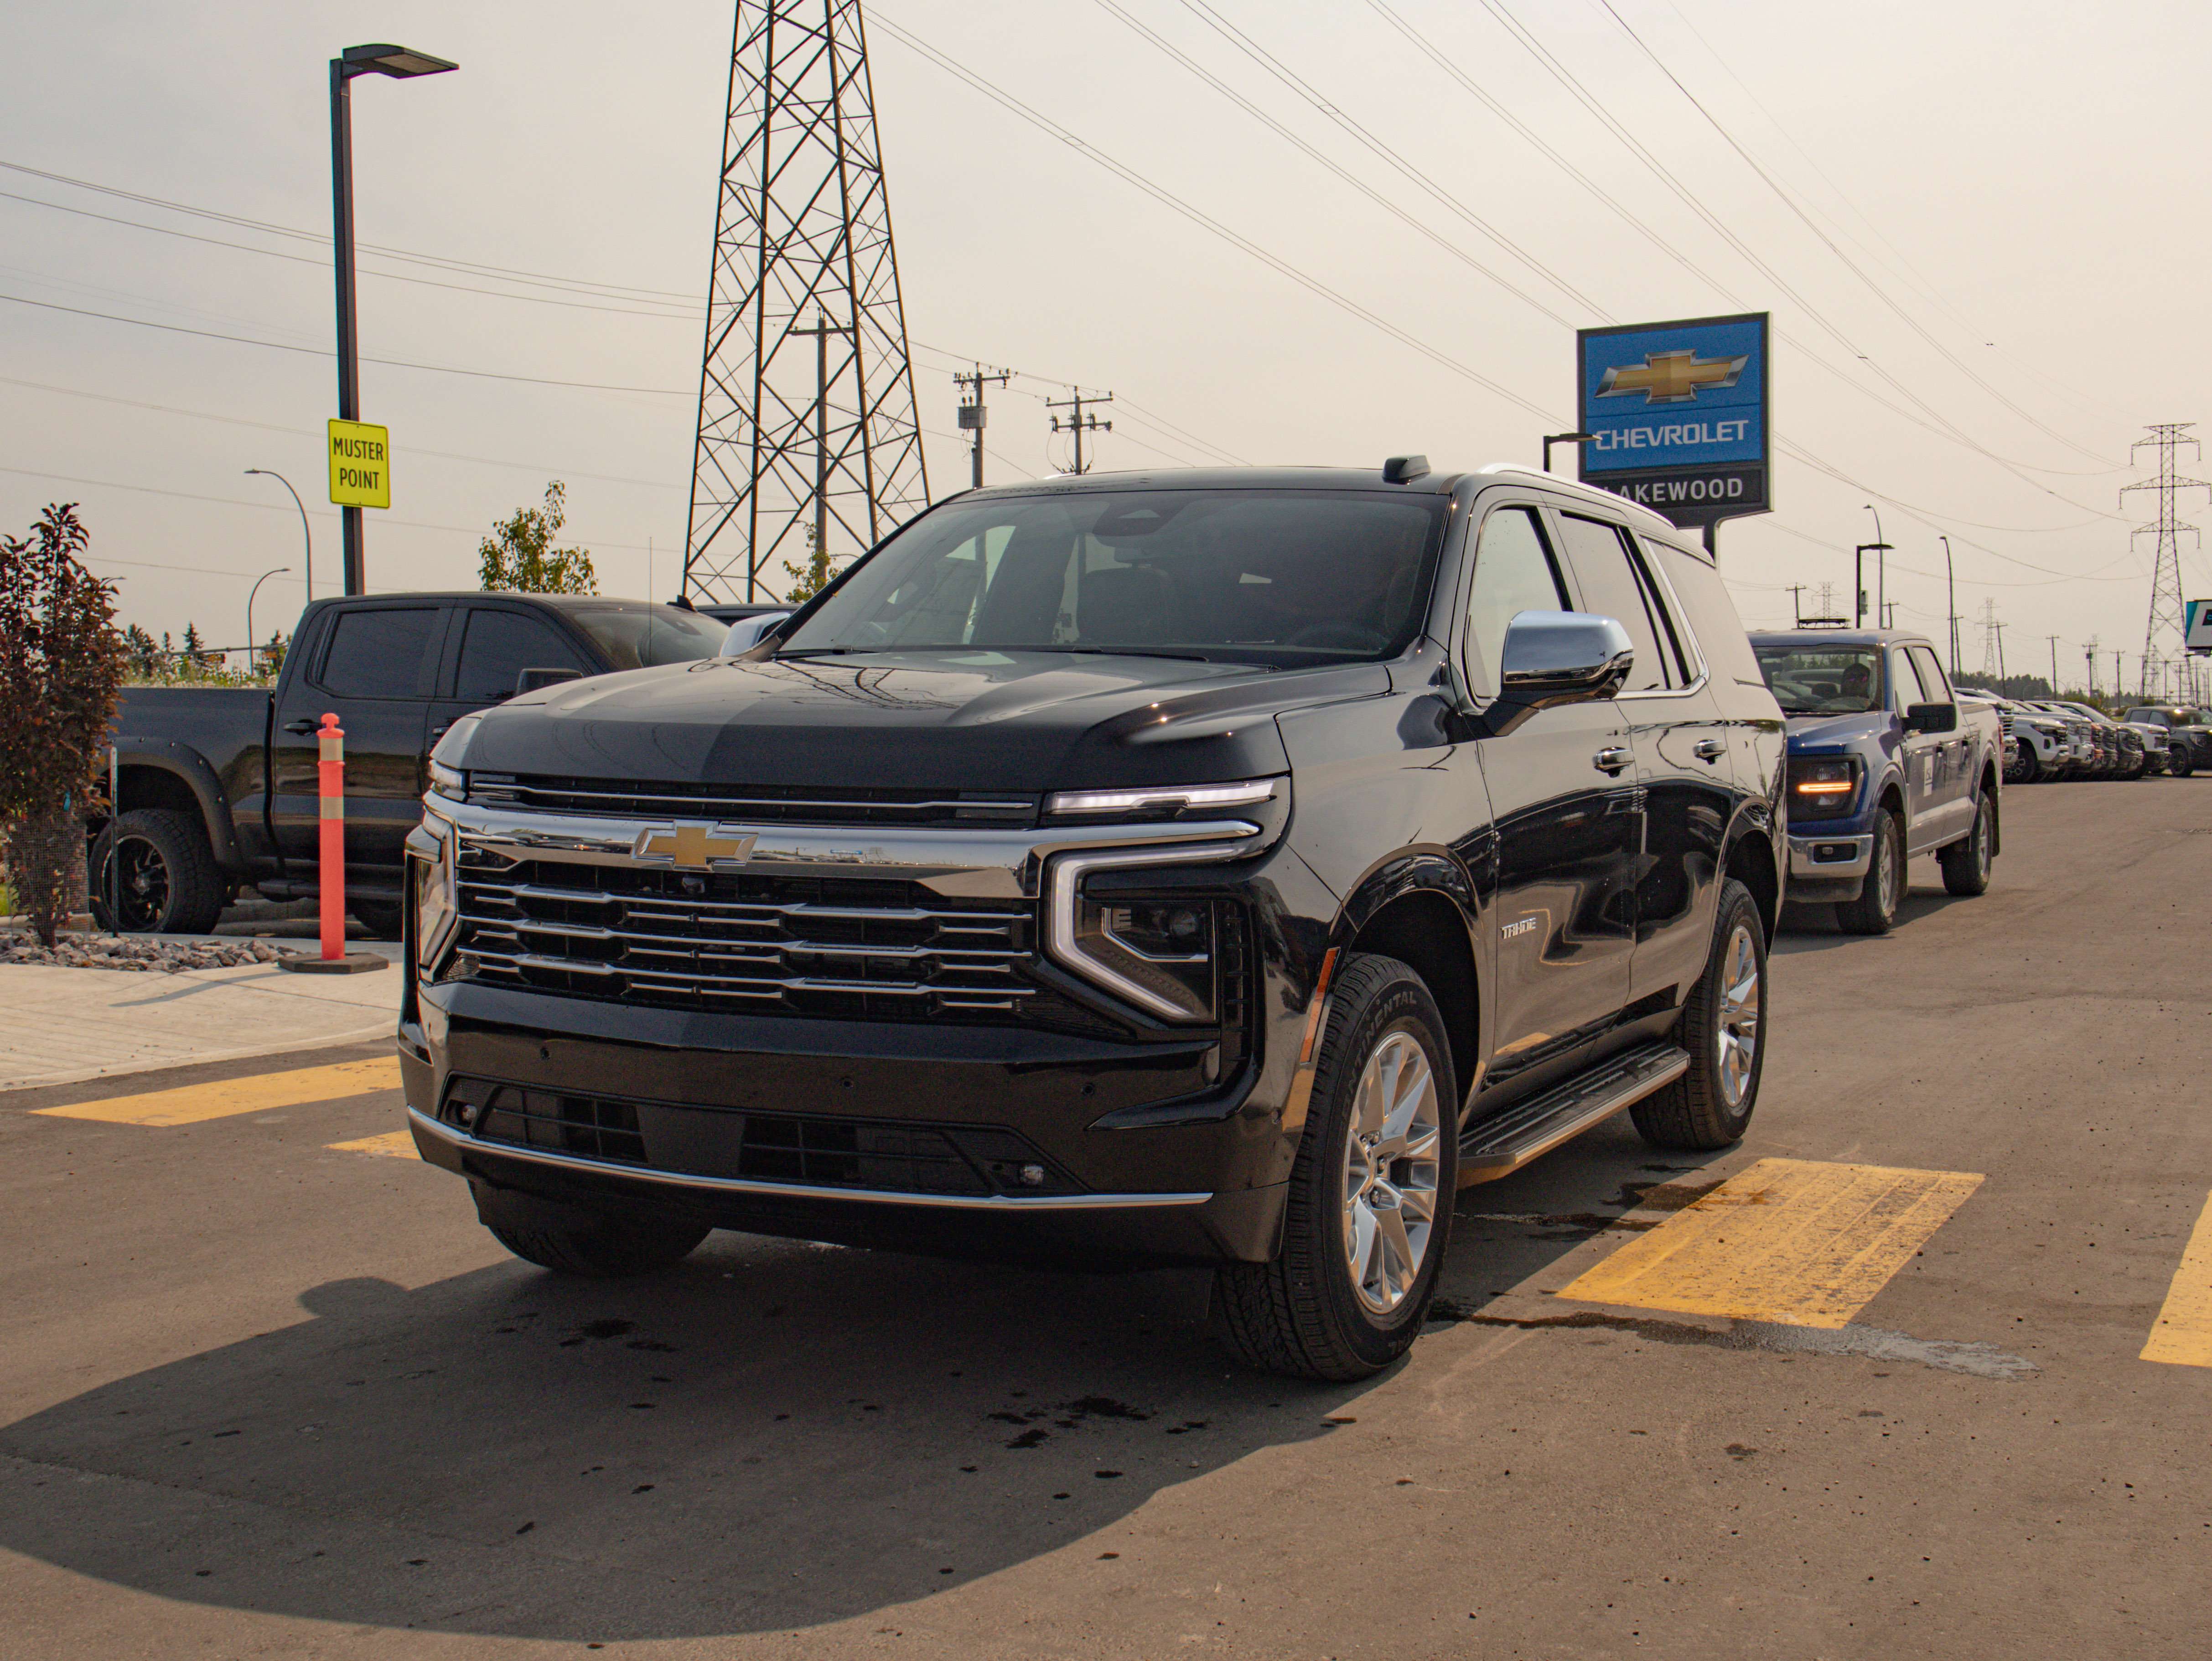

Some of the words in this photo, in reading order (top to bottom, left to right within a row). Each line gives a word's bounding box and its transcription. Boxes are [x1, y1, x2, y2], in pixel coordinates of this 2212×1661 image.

[1596, 420, 1749, 450] CHEVROLET
[333, 436, 384, 461] MUSTER
[339, 467, 379, 490] POINT
[1501, 917, 1536, 940] TAHOE
